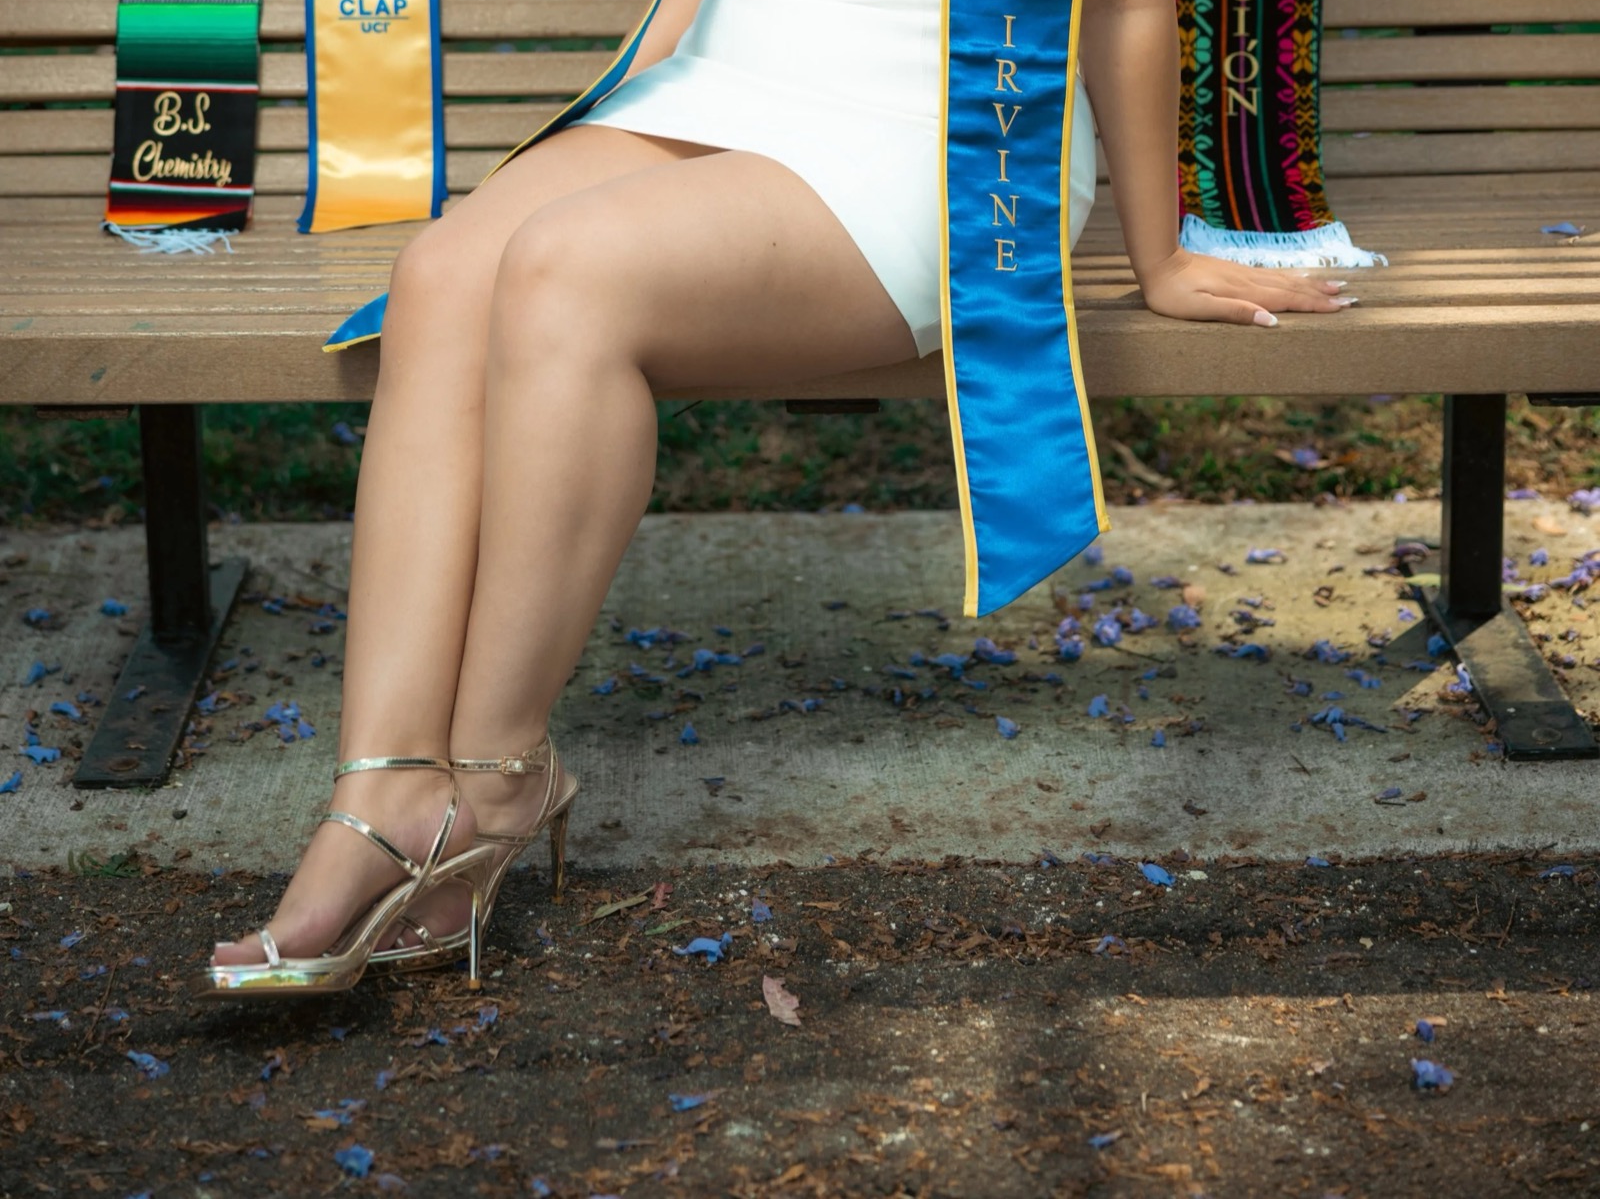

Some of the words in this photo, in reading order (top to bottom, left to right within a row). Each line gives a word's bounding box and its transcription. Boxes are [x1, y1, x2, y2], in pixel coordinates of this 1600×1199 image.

[361, 22, 390, 34] UCI
[153, 91, 211, 136] B.S.
[132, 140, 232, 188] Chemistry
[989, 14, 1023, 272] IRVINE
